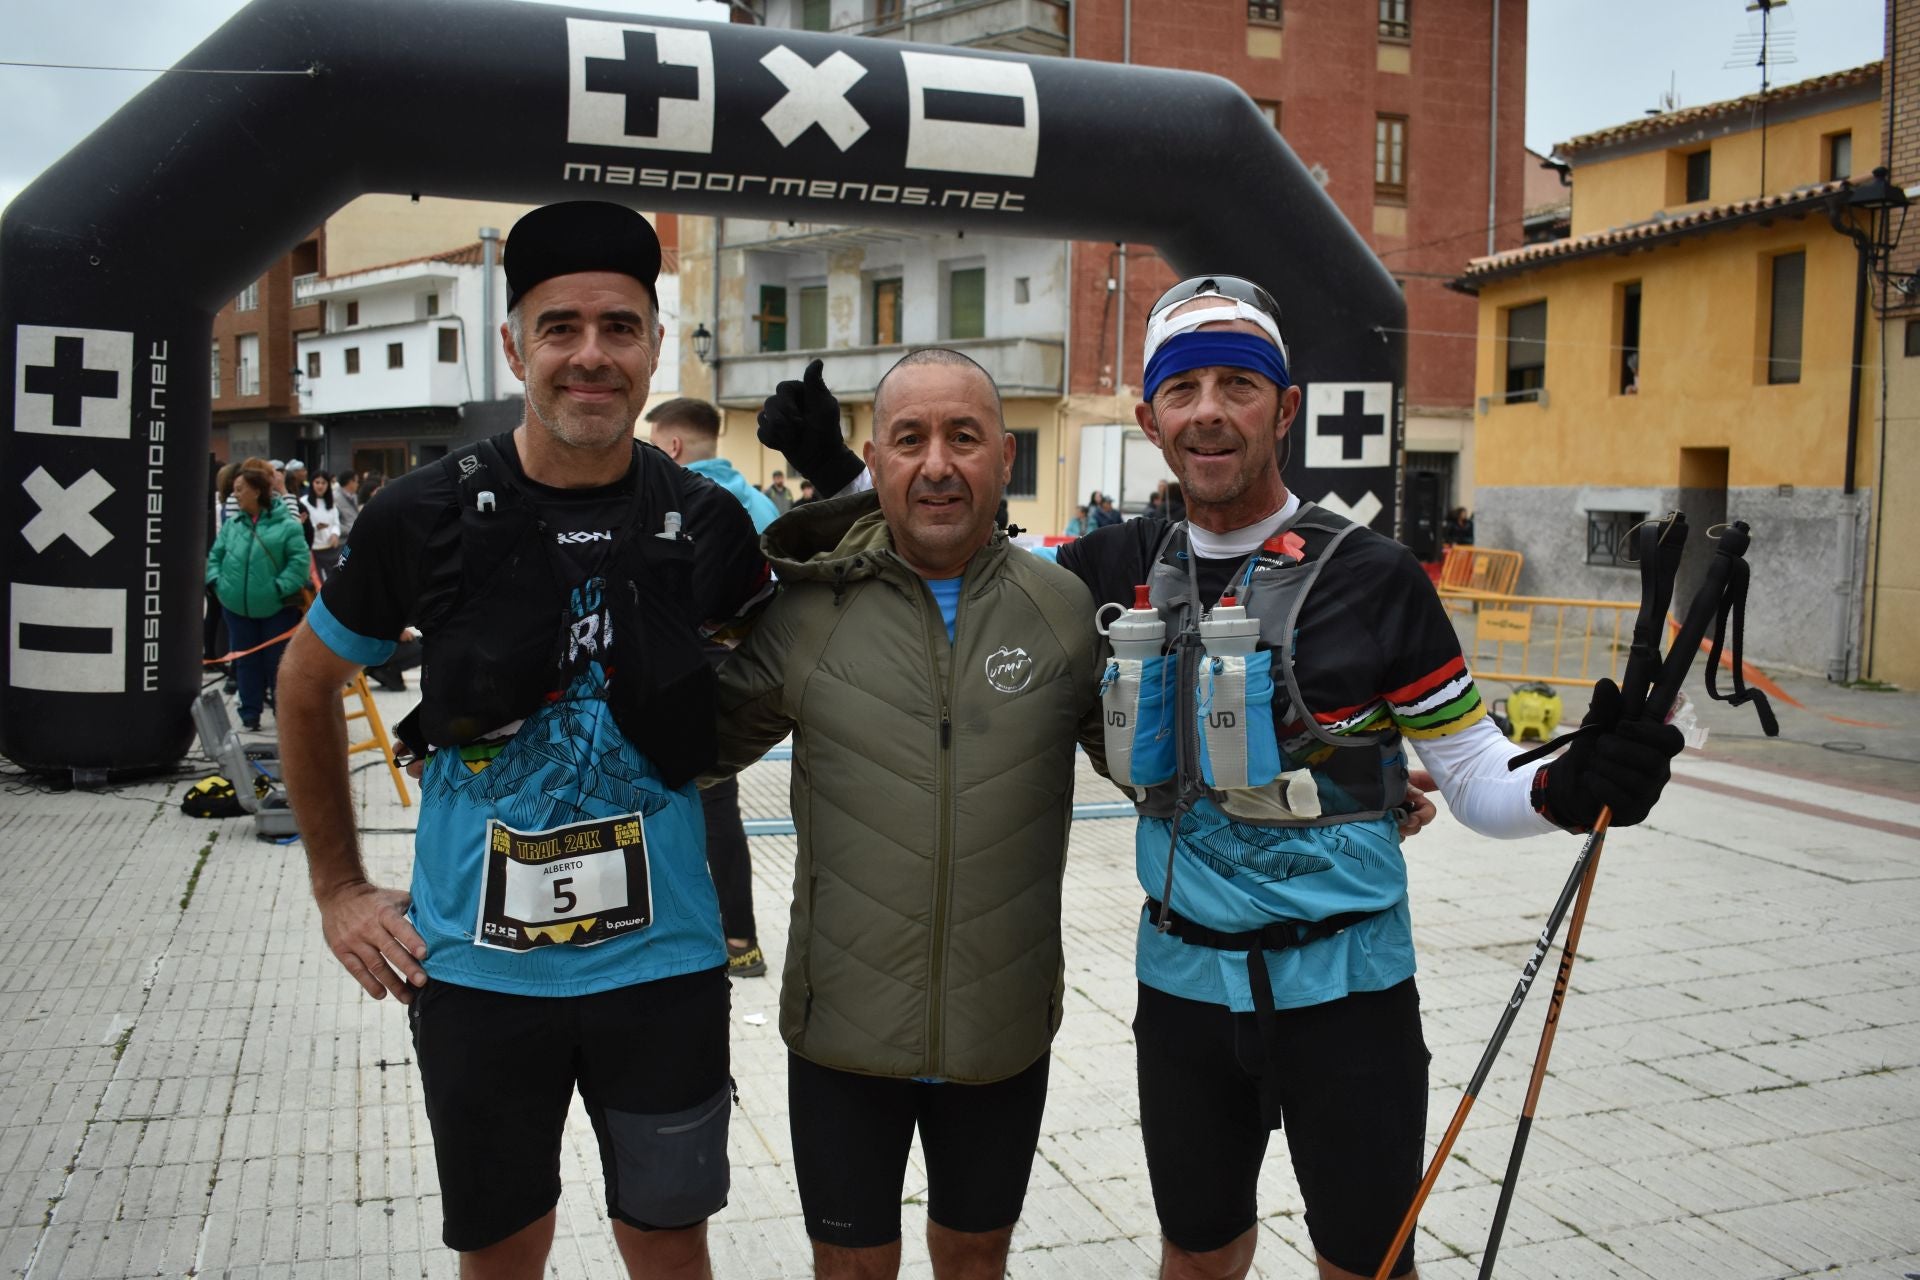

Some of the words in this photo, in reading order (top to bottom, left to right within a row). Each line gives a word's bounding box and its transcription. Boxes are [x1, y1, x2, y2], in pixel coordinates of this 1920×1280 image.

[563, 162, 1026, 213] maspormenos.net
[143, 340, 168, 692] maspormenos.net
[1209, 711, 1236, 729] UD
[516, 839, 561, 860] TRAIL
[564, 830, 602, 853] 24K
[543, 860, 583, 875] ALBERTO
[553, 877, 577, 913] 5
[606, 917, 645, 930] b.power
[822, 1218, 852, 1229] EVADICT
